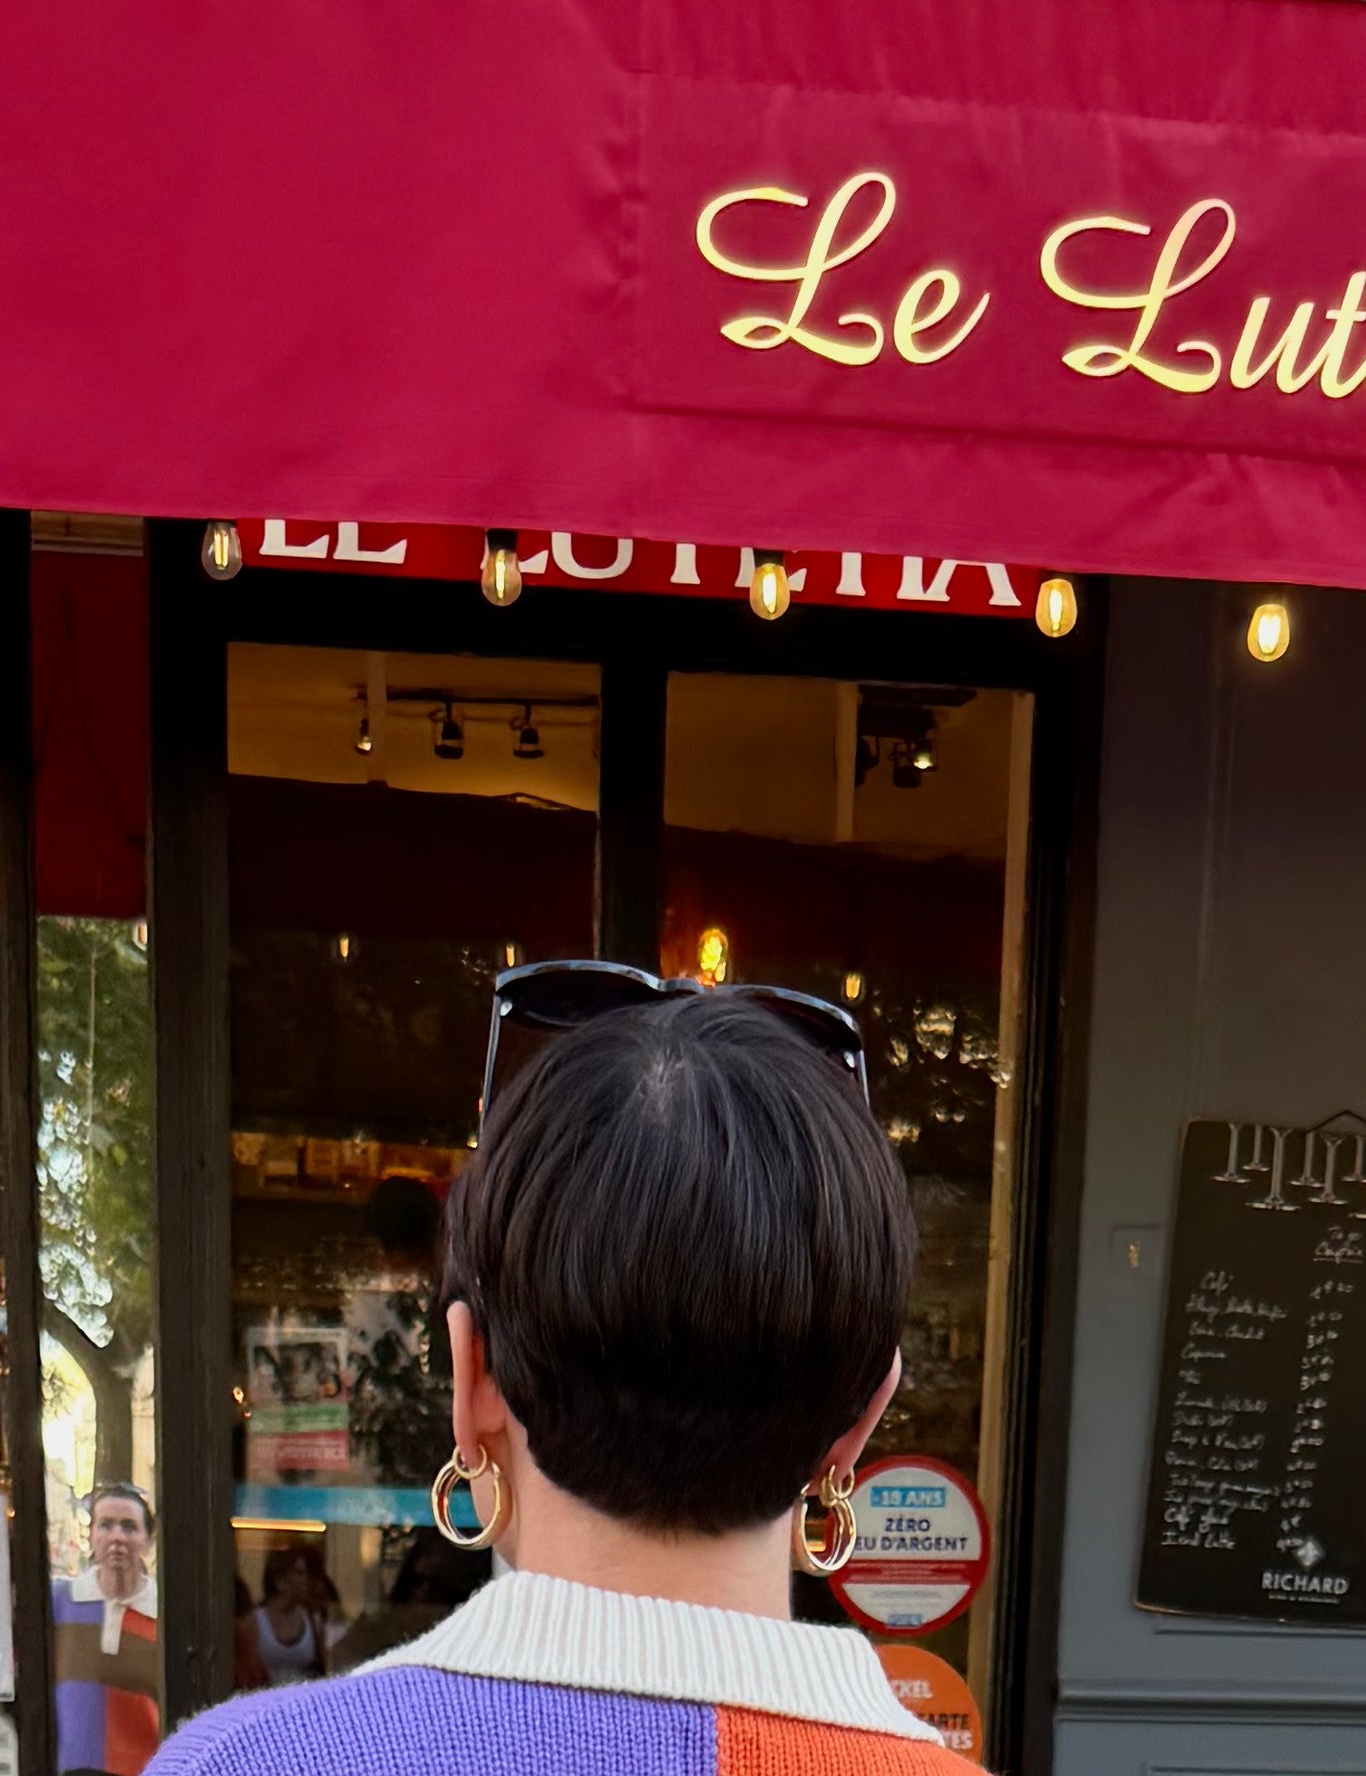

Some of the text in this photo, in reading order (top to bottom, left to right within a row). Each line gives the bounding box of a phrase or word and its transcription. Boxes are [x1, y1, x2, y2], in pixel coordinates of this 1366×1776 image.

[695, 171, 991, 367] Le
[884, 1514, 931, 1533] ZÉRO
[854, 1536, 969, 1551] EU D'ARGENT
[1261, 1571, 1350, 1595] RICHARD
